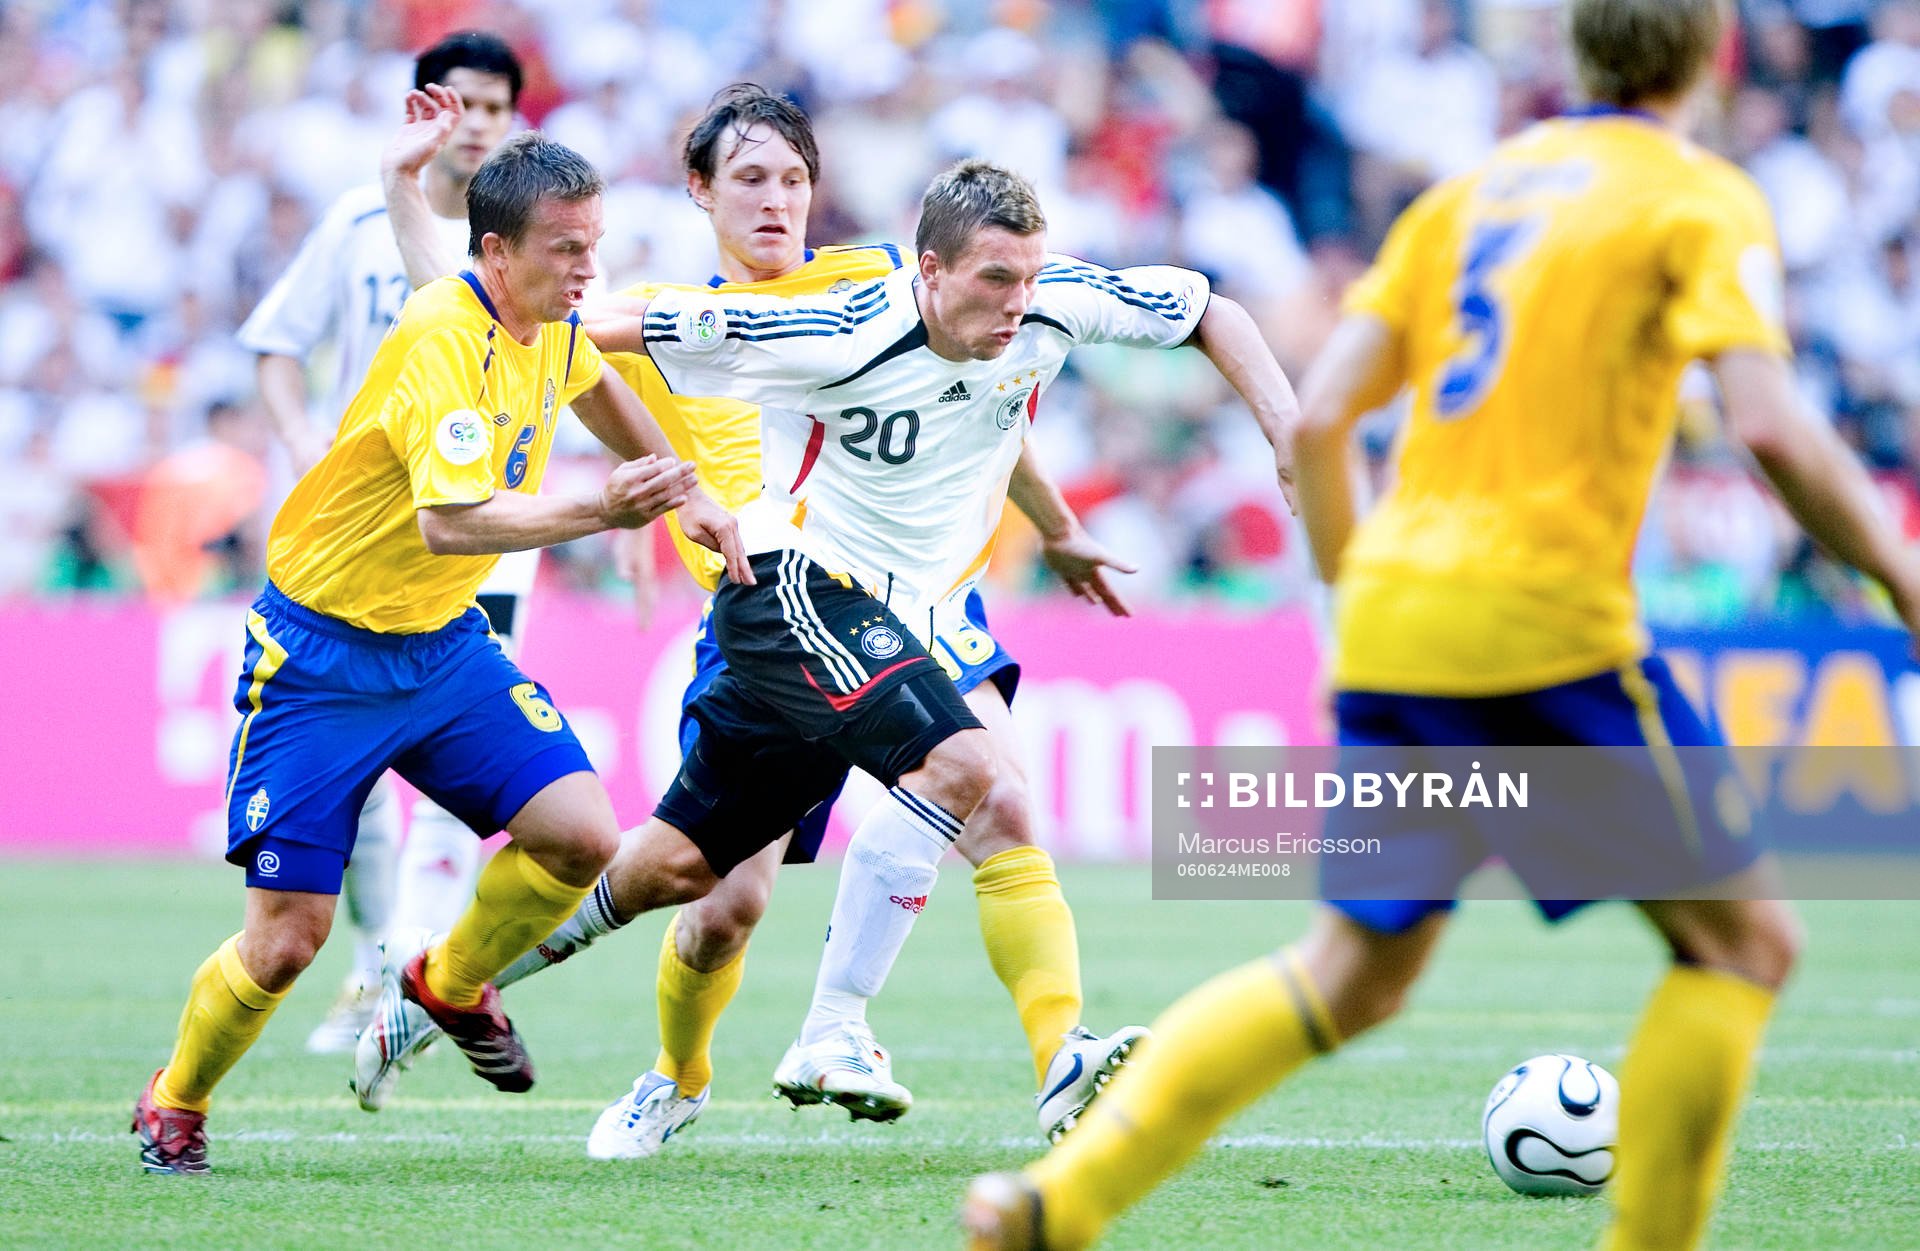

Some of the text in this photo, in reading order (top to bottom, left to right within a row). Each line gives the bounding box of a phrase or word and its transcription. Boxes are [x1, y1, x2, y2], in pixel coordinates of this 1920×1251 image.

[939, 393, 971, 403] adidas
[503, 424, 536, 489] 6
[840, 406, 920, 464] 20
[509, 681, 563, 732] 6
